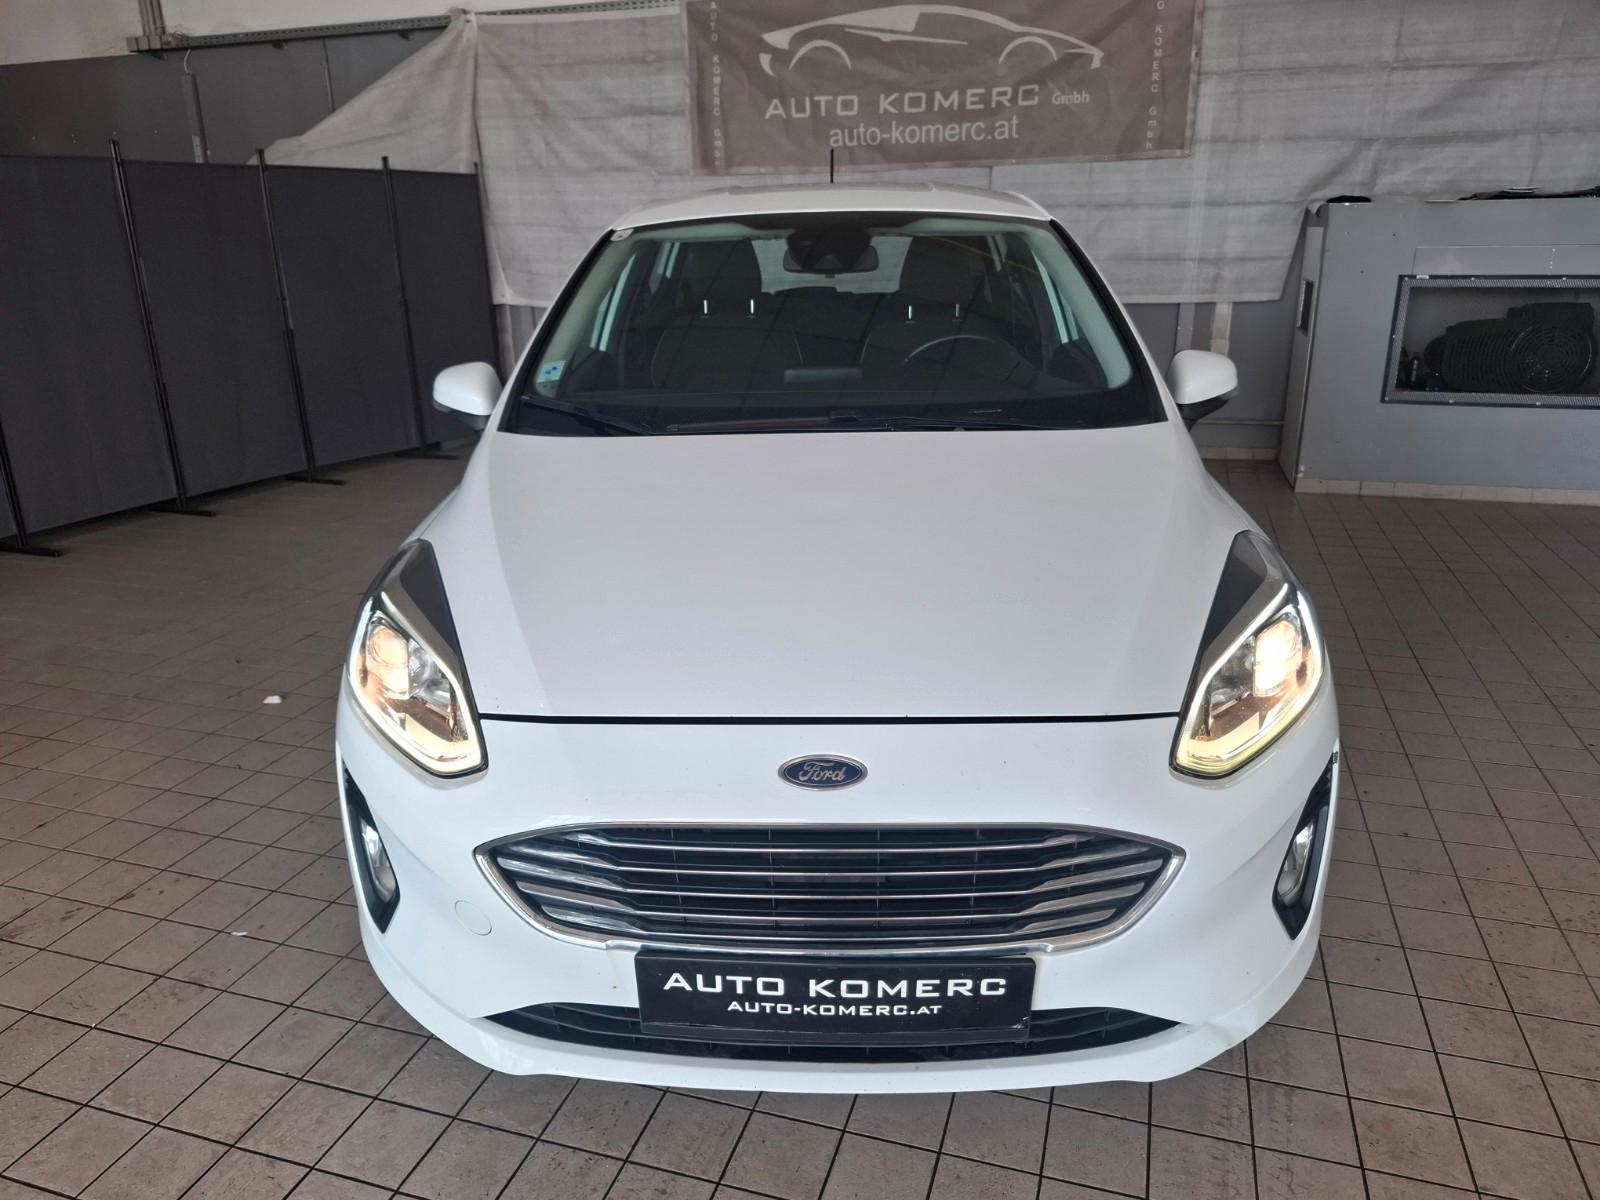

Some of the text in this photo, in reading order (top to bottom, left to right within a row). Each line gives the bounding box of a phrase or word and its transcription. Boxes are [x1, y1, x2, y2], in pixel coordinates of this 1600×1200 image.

[709, 1, 719, 42] AUTO
[1151, 24, 1163, 93] KOMERC
[764, 84, 1090, 120] AUTO KOMERC Gmbh
[828, 114, 1020, 147] auto-komerc.at
[798, 761, 847, 781] Ford
[663, 972, 1007, 998] AUTO KOMERC
[726, 1001, 943, 1017] AUTO-KOMERC.AT
